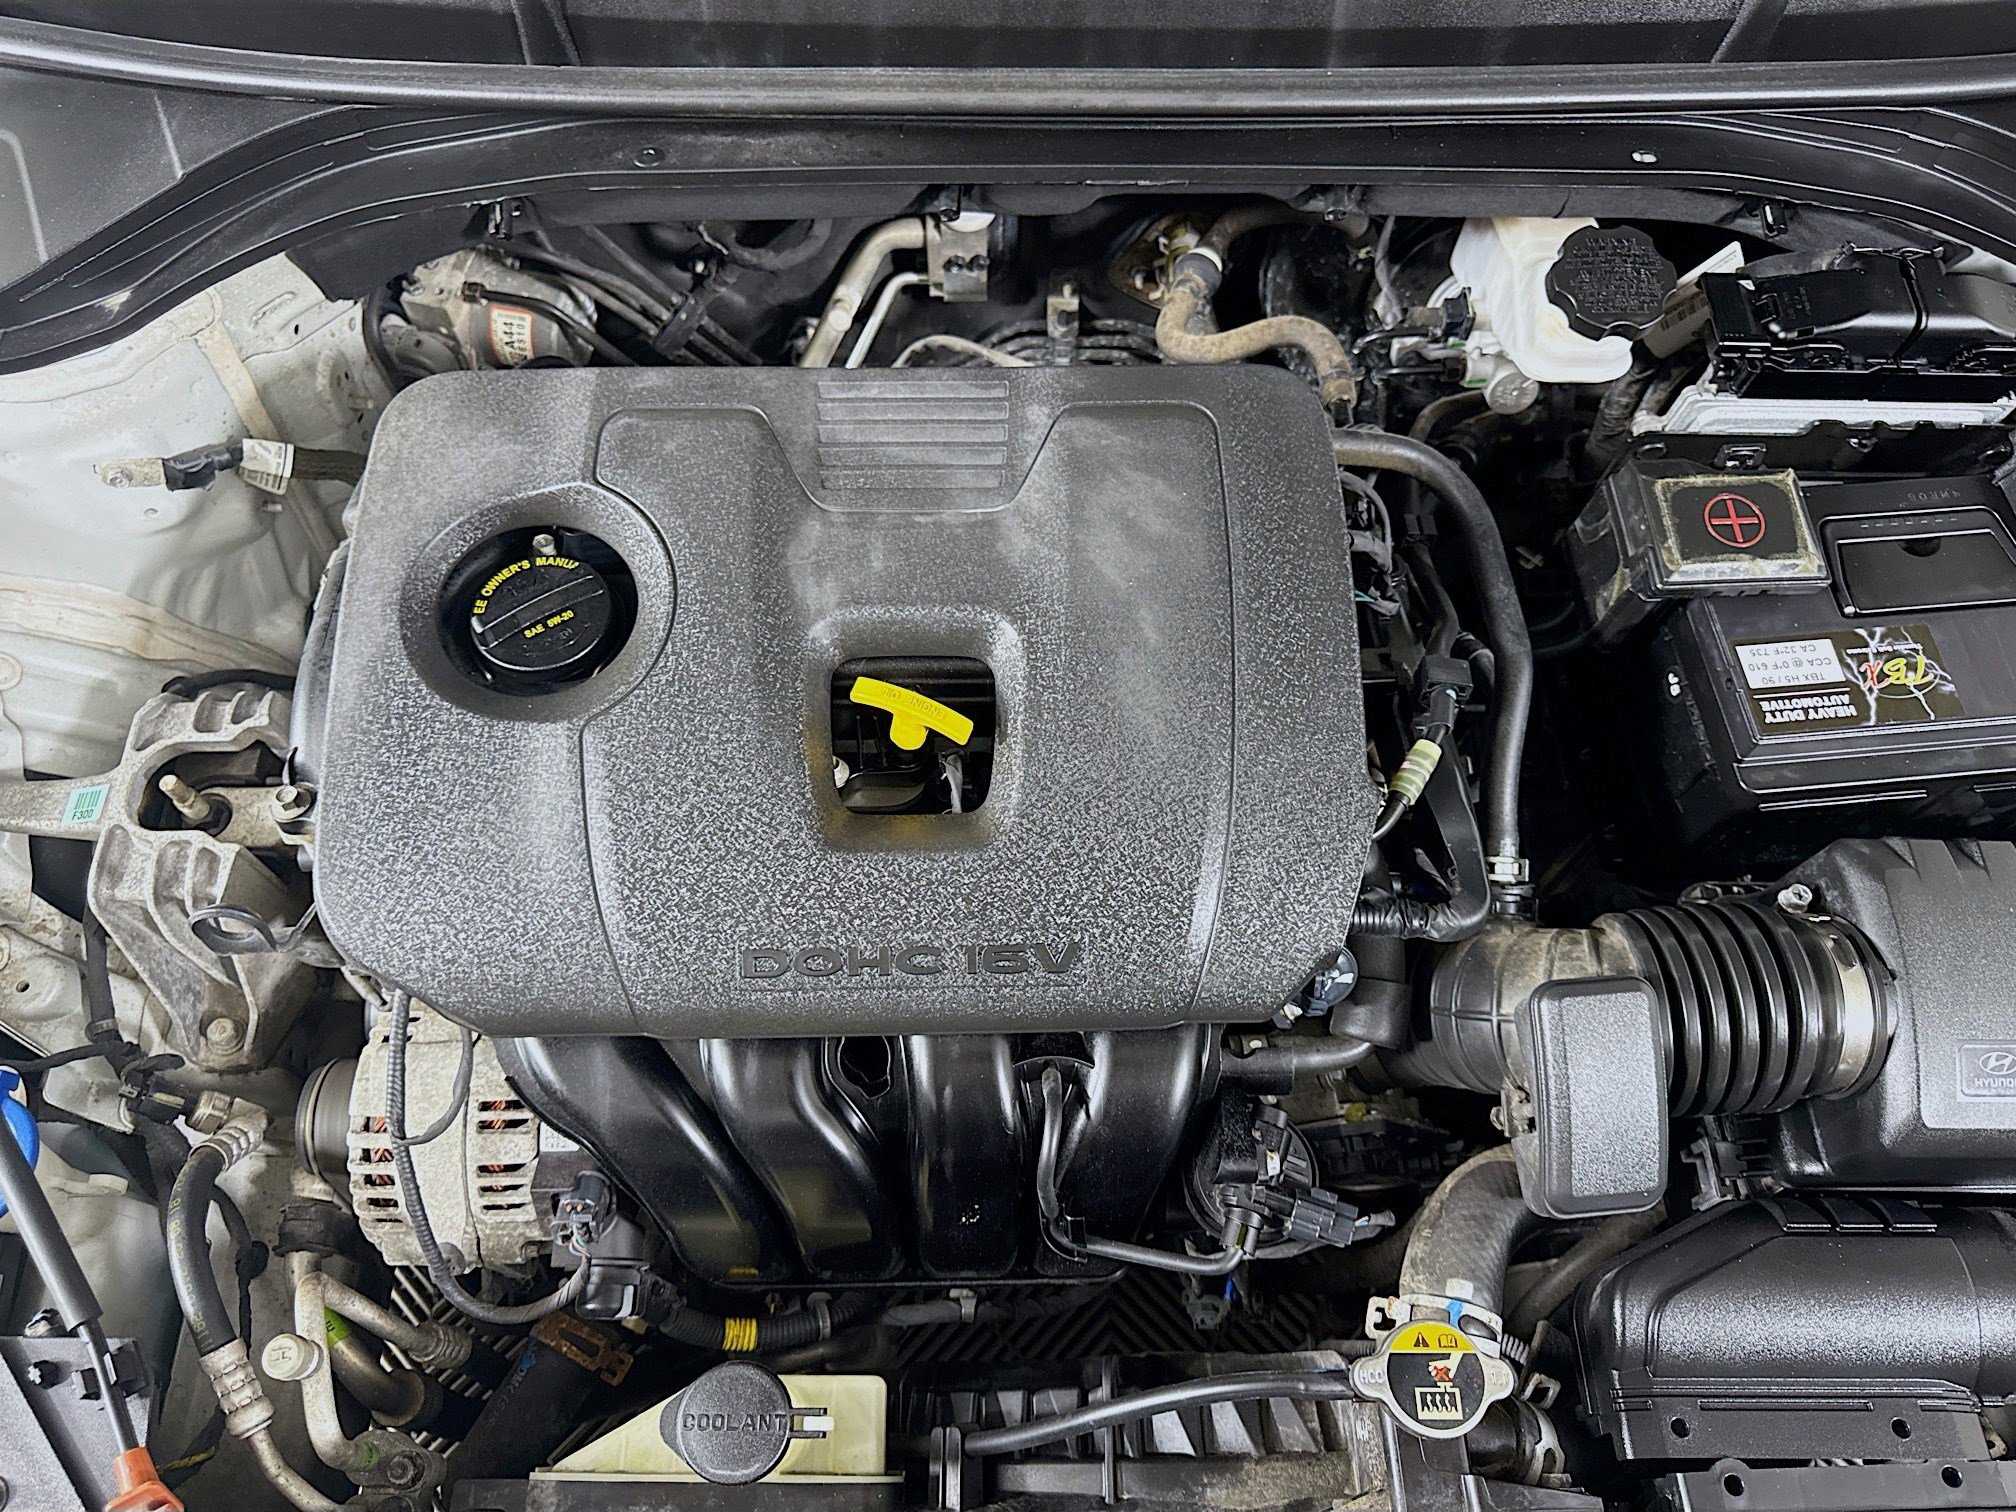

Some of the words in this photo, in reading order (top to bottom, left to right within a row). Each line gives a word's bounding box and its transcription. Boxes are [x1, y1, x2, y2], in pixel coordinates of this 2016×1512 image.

[480, 559, 531, 597] OWNER'S
[523, 624, 545, 638] SAE
[546, 609, 575, 628] 5W-20
[1749, 647, 1770, 657] 735
[1799, 644, 1817, 653] CA
[1748, 662, 1768, 672] 610
[1789, 658, 1804, 668] @
[1807, 657, 1832, 667] CCA
[1802, 672, 1826, 681] TBX
[1860, 655, 1934, 690] TBX
[1761, 676, 1776, 685] 90
[1759, 693, 1850, 712] AUTOMOTIVE
[1764, 709, 1807, 724] DUTY
[1807, 705, 1858, 720] HEAVY
[71, 808, 94, 821] F300
[741, 946, 945, 978] DOHC
[957, 942, 1082, 975] 16V
[1974, 1076, 2016, 1088] HYUND
[682, 1413, 788, 1432] COOLANT
